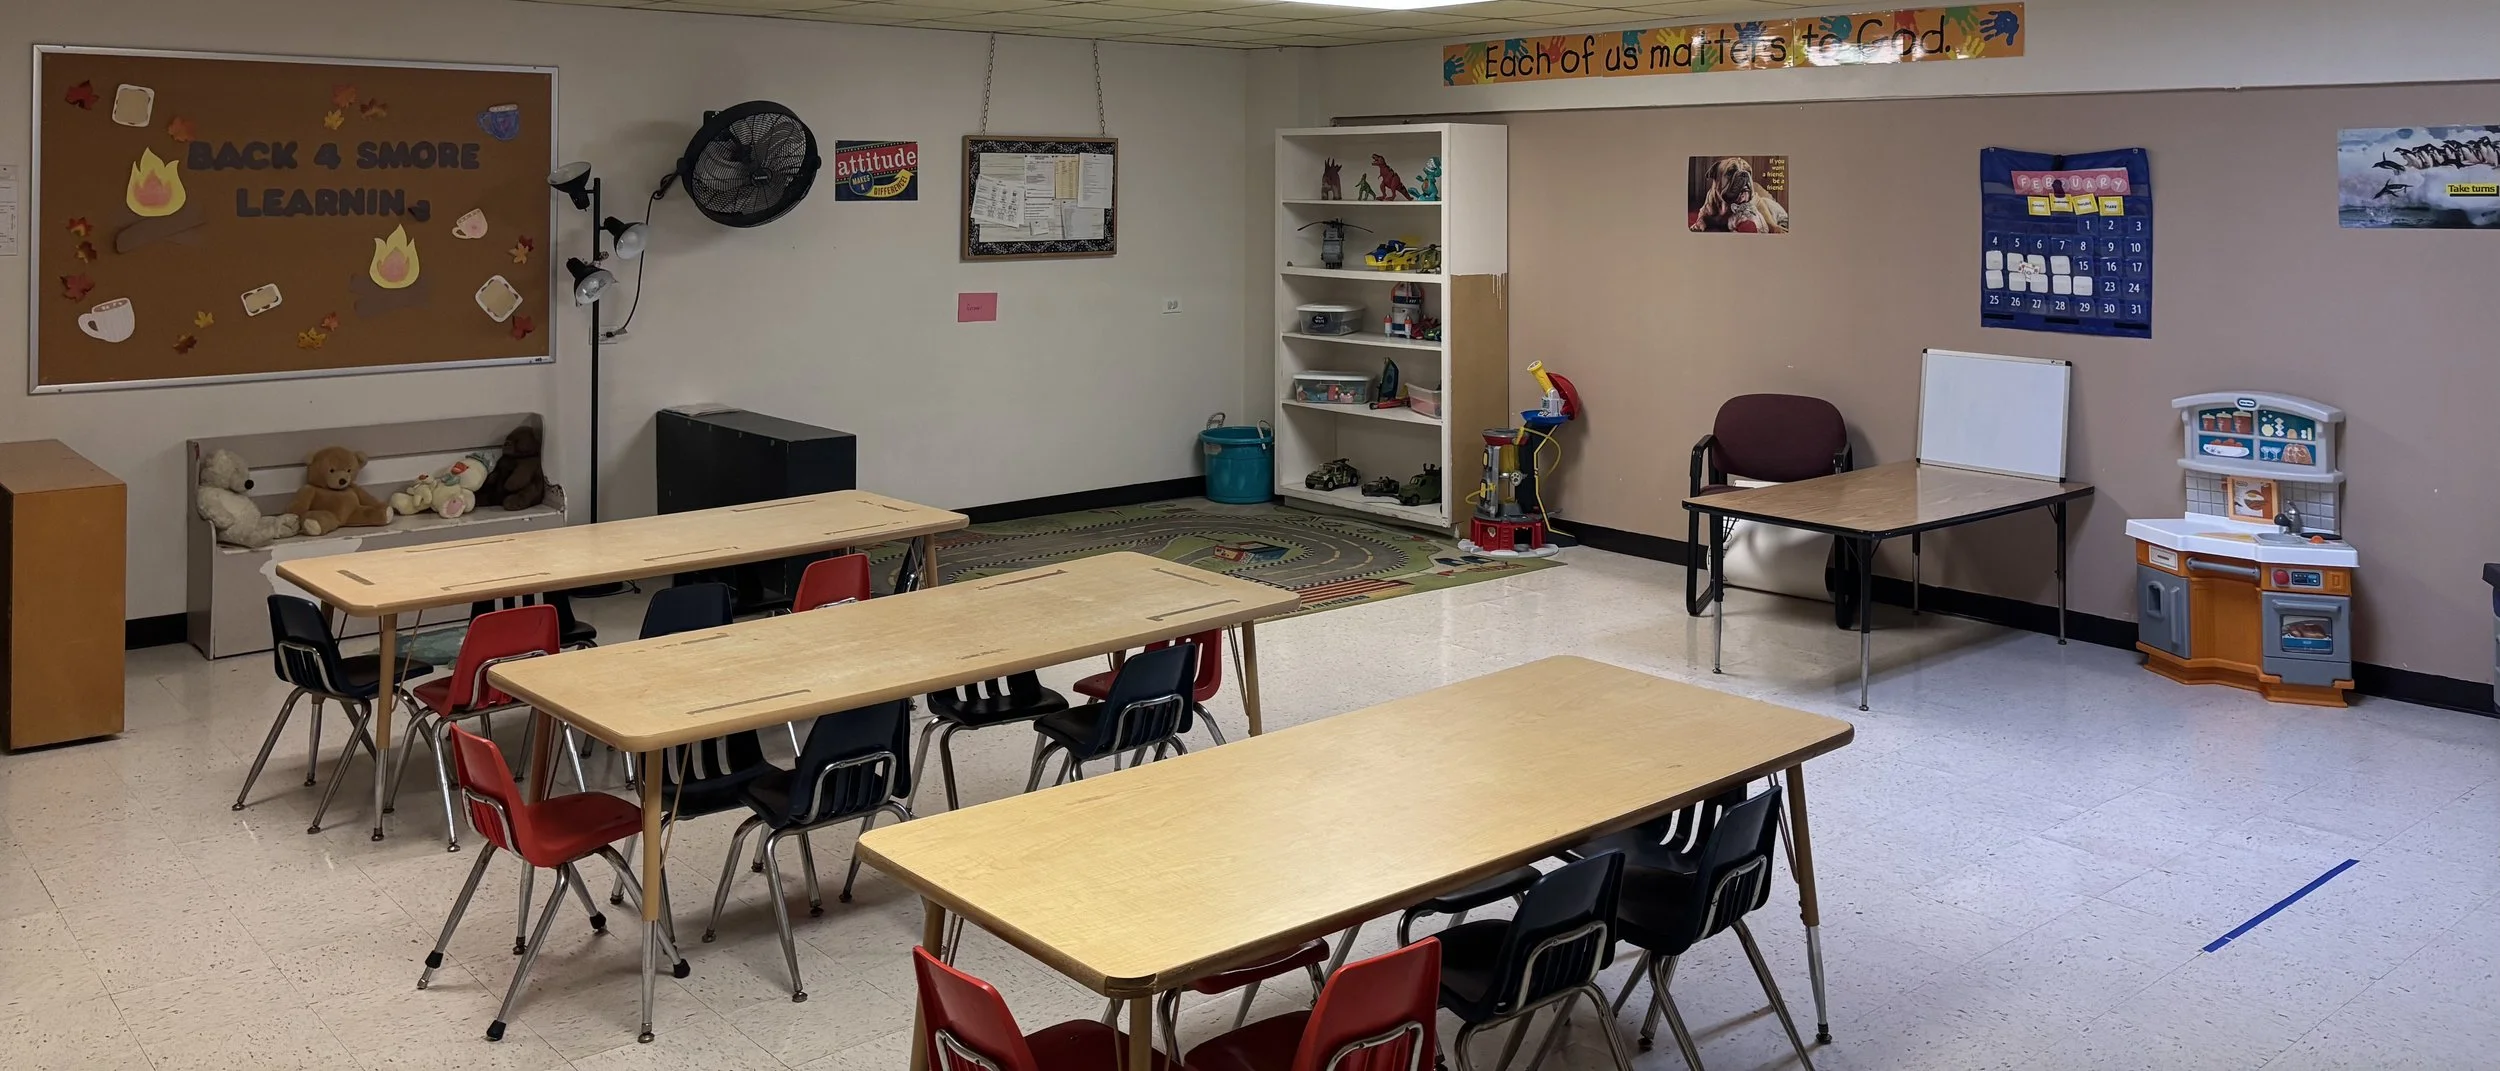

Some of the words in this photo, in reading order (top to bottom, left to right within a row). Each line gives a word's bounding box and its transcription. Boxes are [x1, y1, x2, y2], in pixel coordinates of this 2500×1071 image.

[1485, 42, 1551, 80] Each
[1560, 34, 1594, 75] of
[1606, 46, 1638, 72] us
[1650, 28, 1786, 69] matters
[1802, 24, 1843, 58] to
[1857, 15, 1950, 56] God.
[186, 140, 298, 170] BACK
[313, 142, 342, 170] 4
[356, 142, 480, 170] SMORE
[838, 147, 916, 175] attitude
[852, 174, 870, 185] MAKES
[2086, 221, 2090, 230] 1
[2108, 220, 2114, 230] 2
[2136, 221, 2141, 231] 3
[1992, 236, 1998, 245] 4
[2015, 238, 2020, 247] 5
[2037, 240, 2042, 249] 6
[2059, 241, 2065, 250] 7
[2080, 241, 2086, 251] 8
[2108, 242, 2114, 251] 9
[2130, 243, 2140, 252] 10
[2079, 261, 2088, 270] 15
[2106, 262, 2117, 272] 16
[2132, 262, 2142, 272] 17
[2104, 282, 2116, 292] 23
[2128, 283, 2140, 293] 24
[1989, 296, 1999, 304] 25
[2011, 297, 2020, 306] 26
[2032, 299, 2041, 308] 27
[2055, 301, 2065, 310] 28
[2080, 303, 2090, 312] 29
[2104, 304, 2115, 313] 30
[2131, 304, 2141, 314] 31
